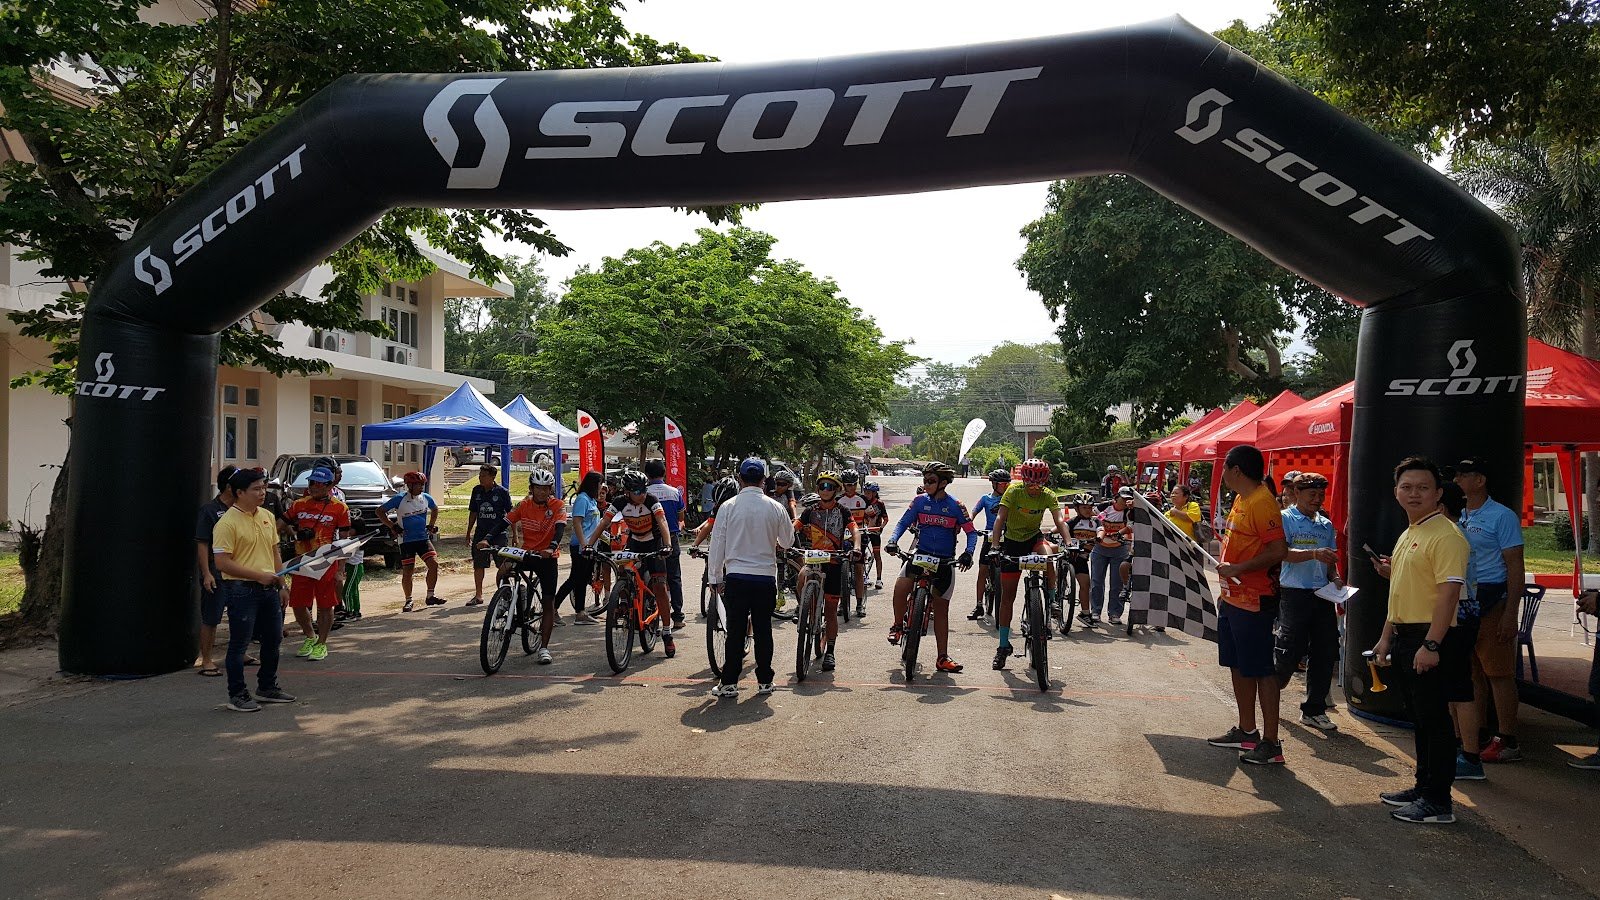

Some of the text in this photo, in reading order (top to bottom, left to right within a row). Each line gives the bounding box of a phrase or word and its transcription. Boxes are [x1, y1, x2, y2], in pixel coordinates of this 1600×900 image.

[525, 66, 1044, 160] SCOTT
[173, 144, 307, 267] SCOTT
[1221, 128, 1434, 246] SCOTT
[1384, 375, 1523, 396] SCOTT
